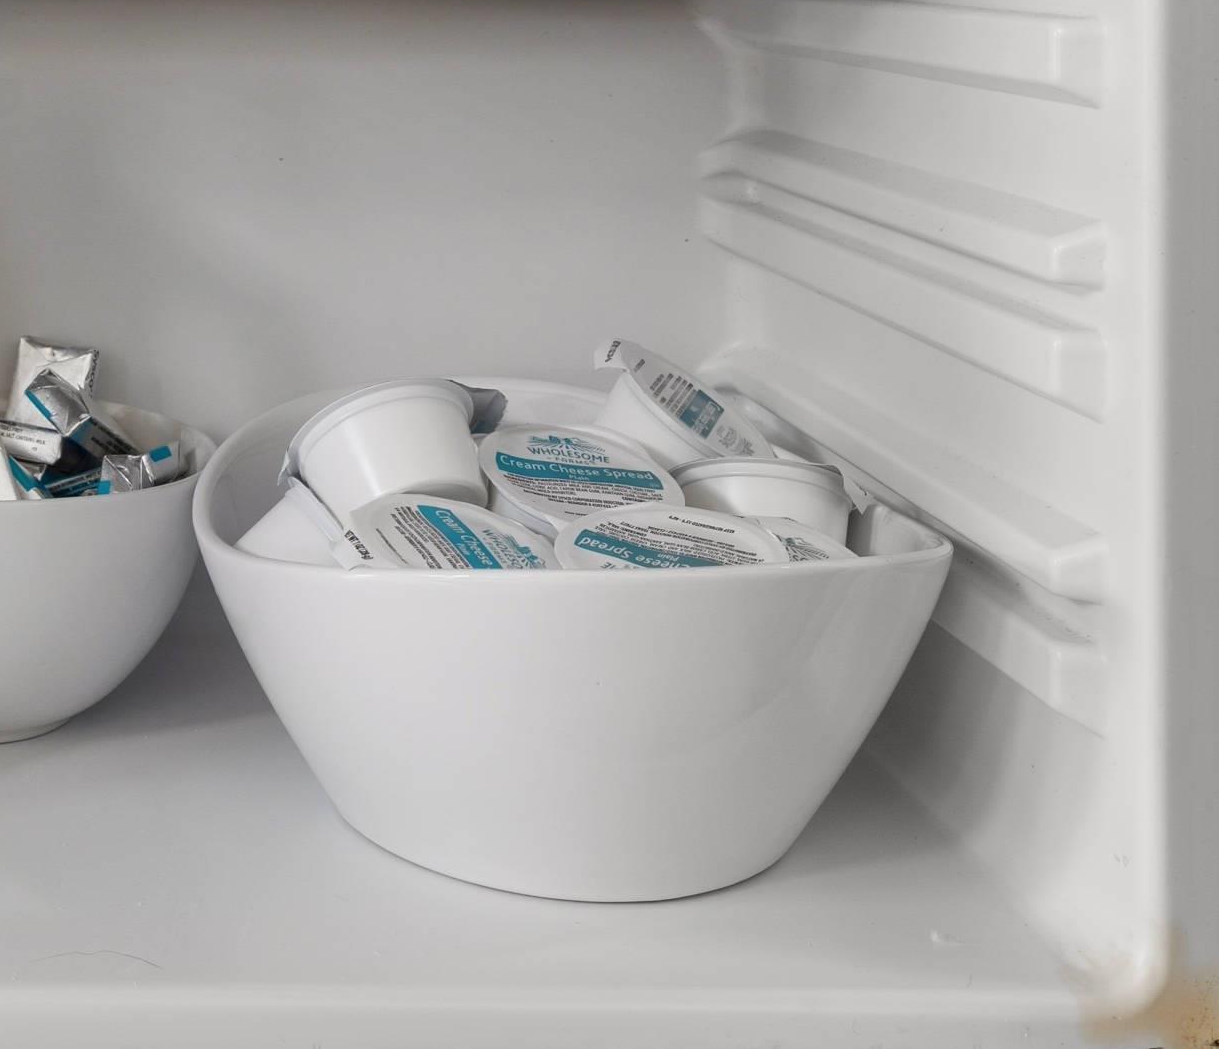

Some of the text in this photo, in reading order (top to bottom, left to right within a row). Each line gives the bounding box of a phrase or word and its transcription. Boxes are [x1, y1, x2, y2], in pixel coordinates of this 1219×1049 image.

[527, 446, 610, 464] WHOLESOME
[500, 455, 654, 482] Cream Cheese Spread
[434, 508, 466, 542] Cream
[461, 532, 494, 568] Cheese
[578, 536, 633, 560] Spread
[656, 553, 680, 562] Plain
